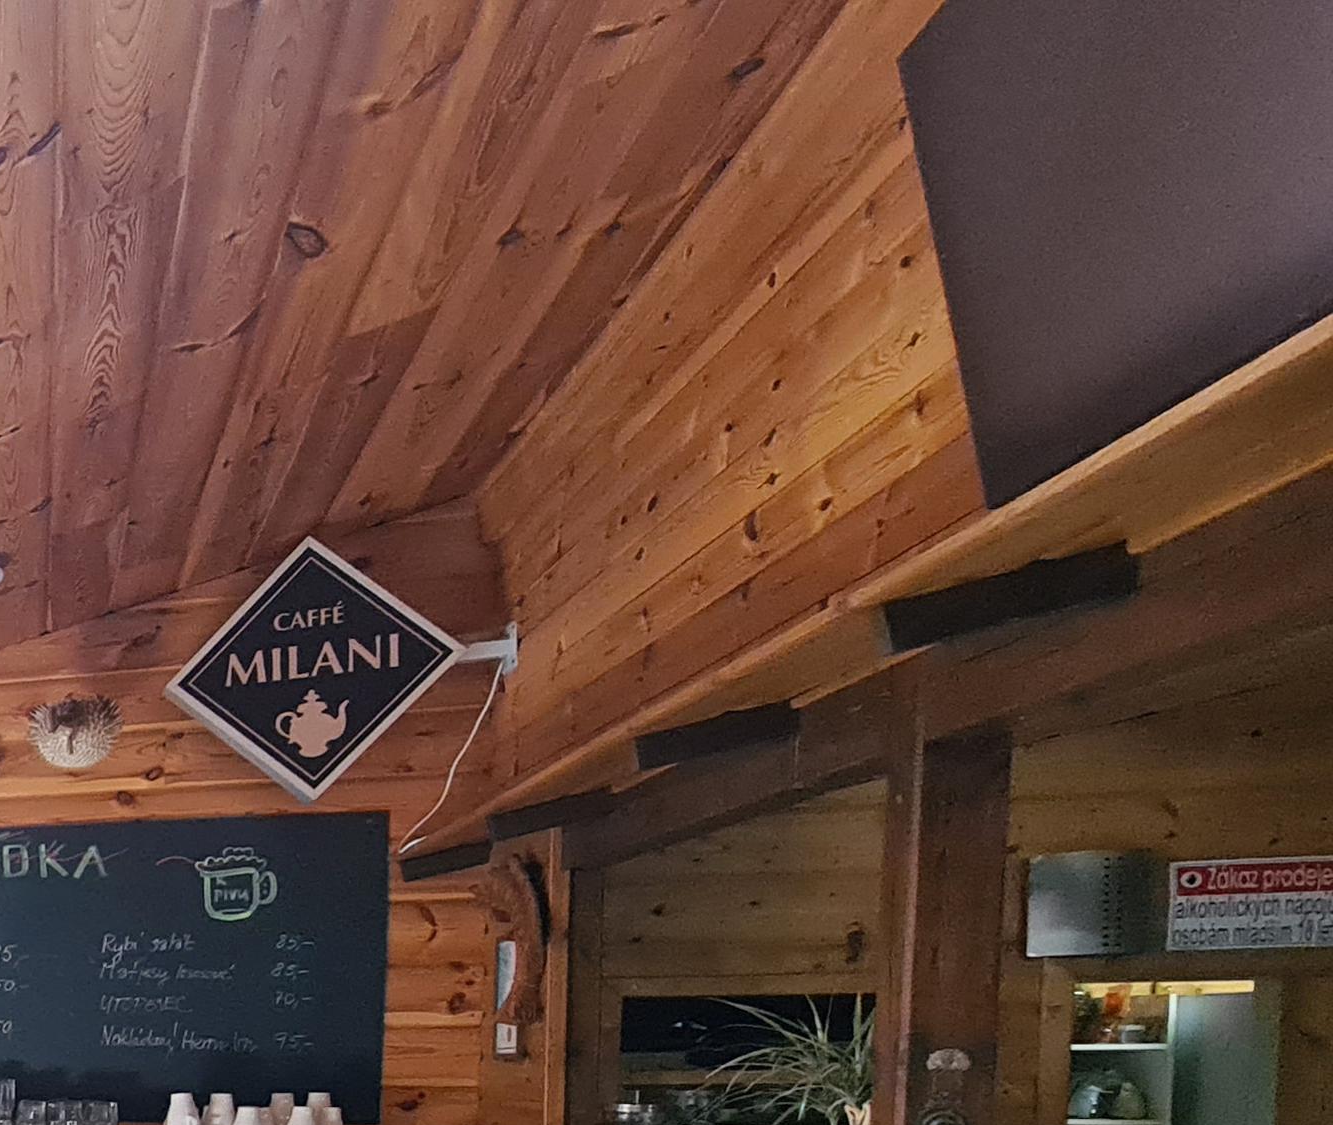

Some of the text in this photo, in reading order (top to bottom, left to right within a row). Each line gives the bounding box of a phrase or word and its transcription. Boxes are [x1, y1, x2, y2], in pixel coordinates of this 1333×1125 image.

[273, 600, 345, 632] CAFFÉ
[224, 632, 400, 688] MILANI
[1206, 862, 1333, 891] Zákaz prodeje
